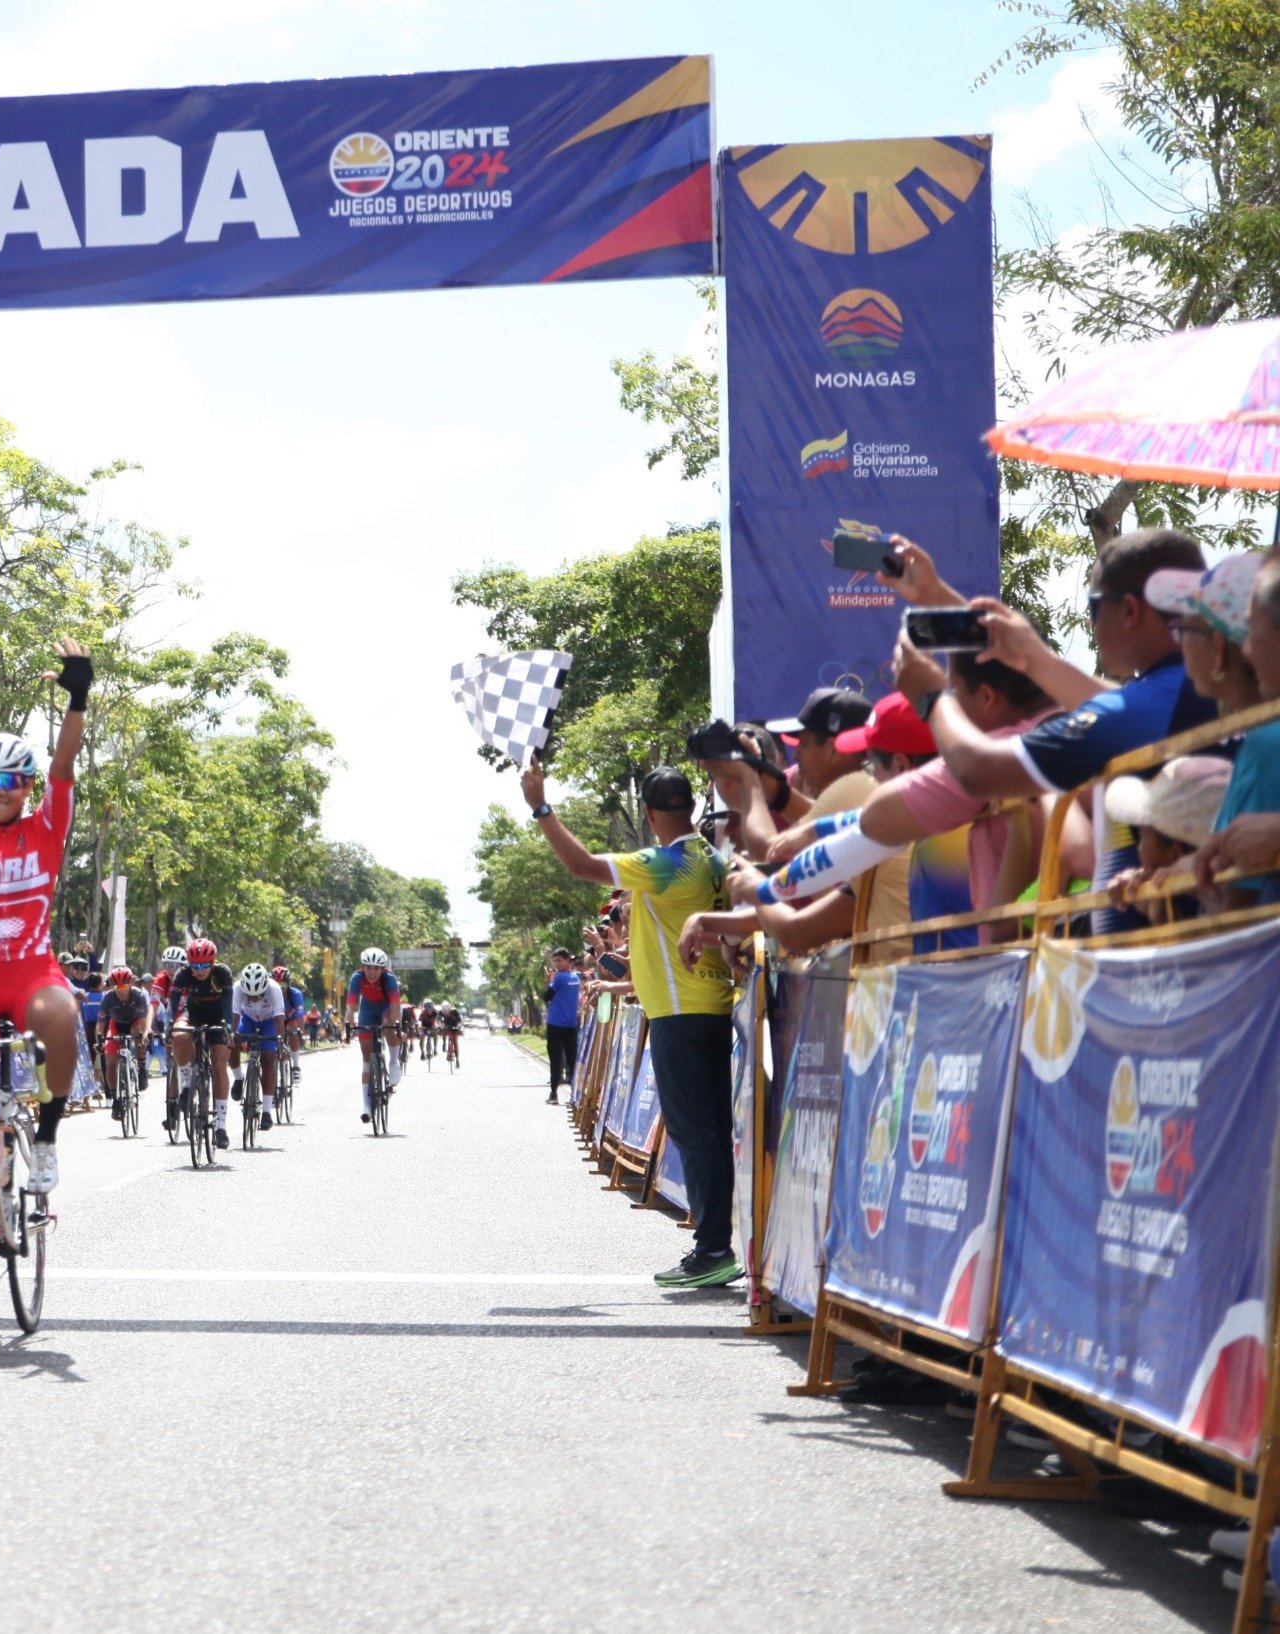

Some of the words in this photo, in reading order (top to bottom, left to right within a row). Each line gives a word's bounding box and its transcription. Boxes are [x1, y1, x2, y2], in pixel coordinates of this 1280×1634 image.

[394, 126, 509, 152] ORIENTE
[391, 150, 510, 190] 2024
[329, 197, 396, 217] JUEGOS
[404, 191, 512, 213] DEPORTIVOS
[349, 214, 404, 227] NACIONALES
[407, 215, 413, 224] Y
[416, 210, 494, 224] PARANACIONALES
[815, 371, 916, 388] MONAGAS
[853, 442, 910, 454] Gobierno
[853, 453, 928, 466] Bolivariano
[853, 466, 870, 477] de
[873, 465, 938, 477] Venezuela
[831, 594, 895, 607] Mindeporte
[1139, 1058, 1203, 1107] ORIENTE
[1129, 1115, 1196, 1204] 2024
